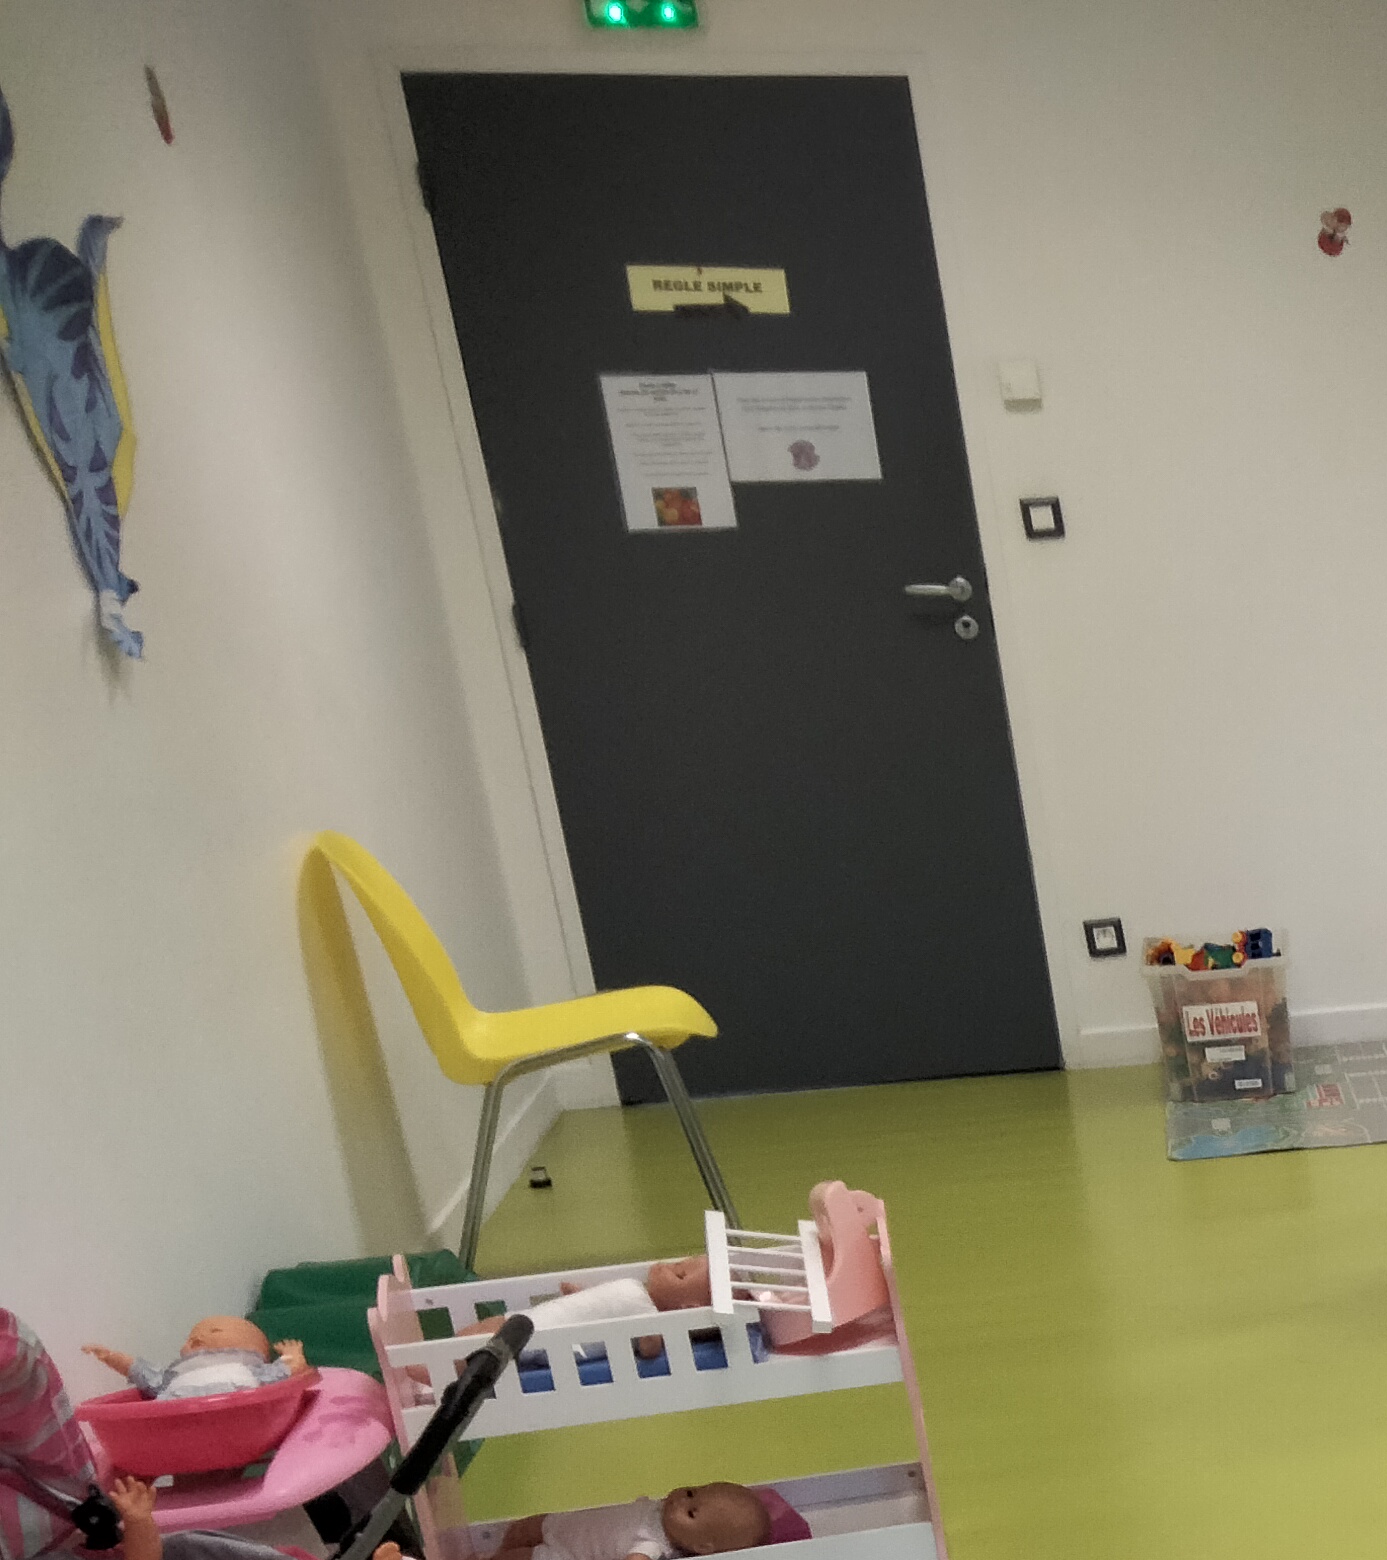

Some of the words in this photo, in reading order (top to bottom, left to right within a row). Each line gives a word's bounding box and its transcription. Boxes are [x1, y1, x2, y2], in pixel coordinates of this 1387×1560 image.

[652, 279, 702, 292] REGLE
[707, 280, 763, 293] SIMPLE
[1185, 1011, 1206, 1037] Les
